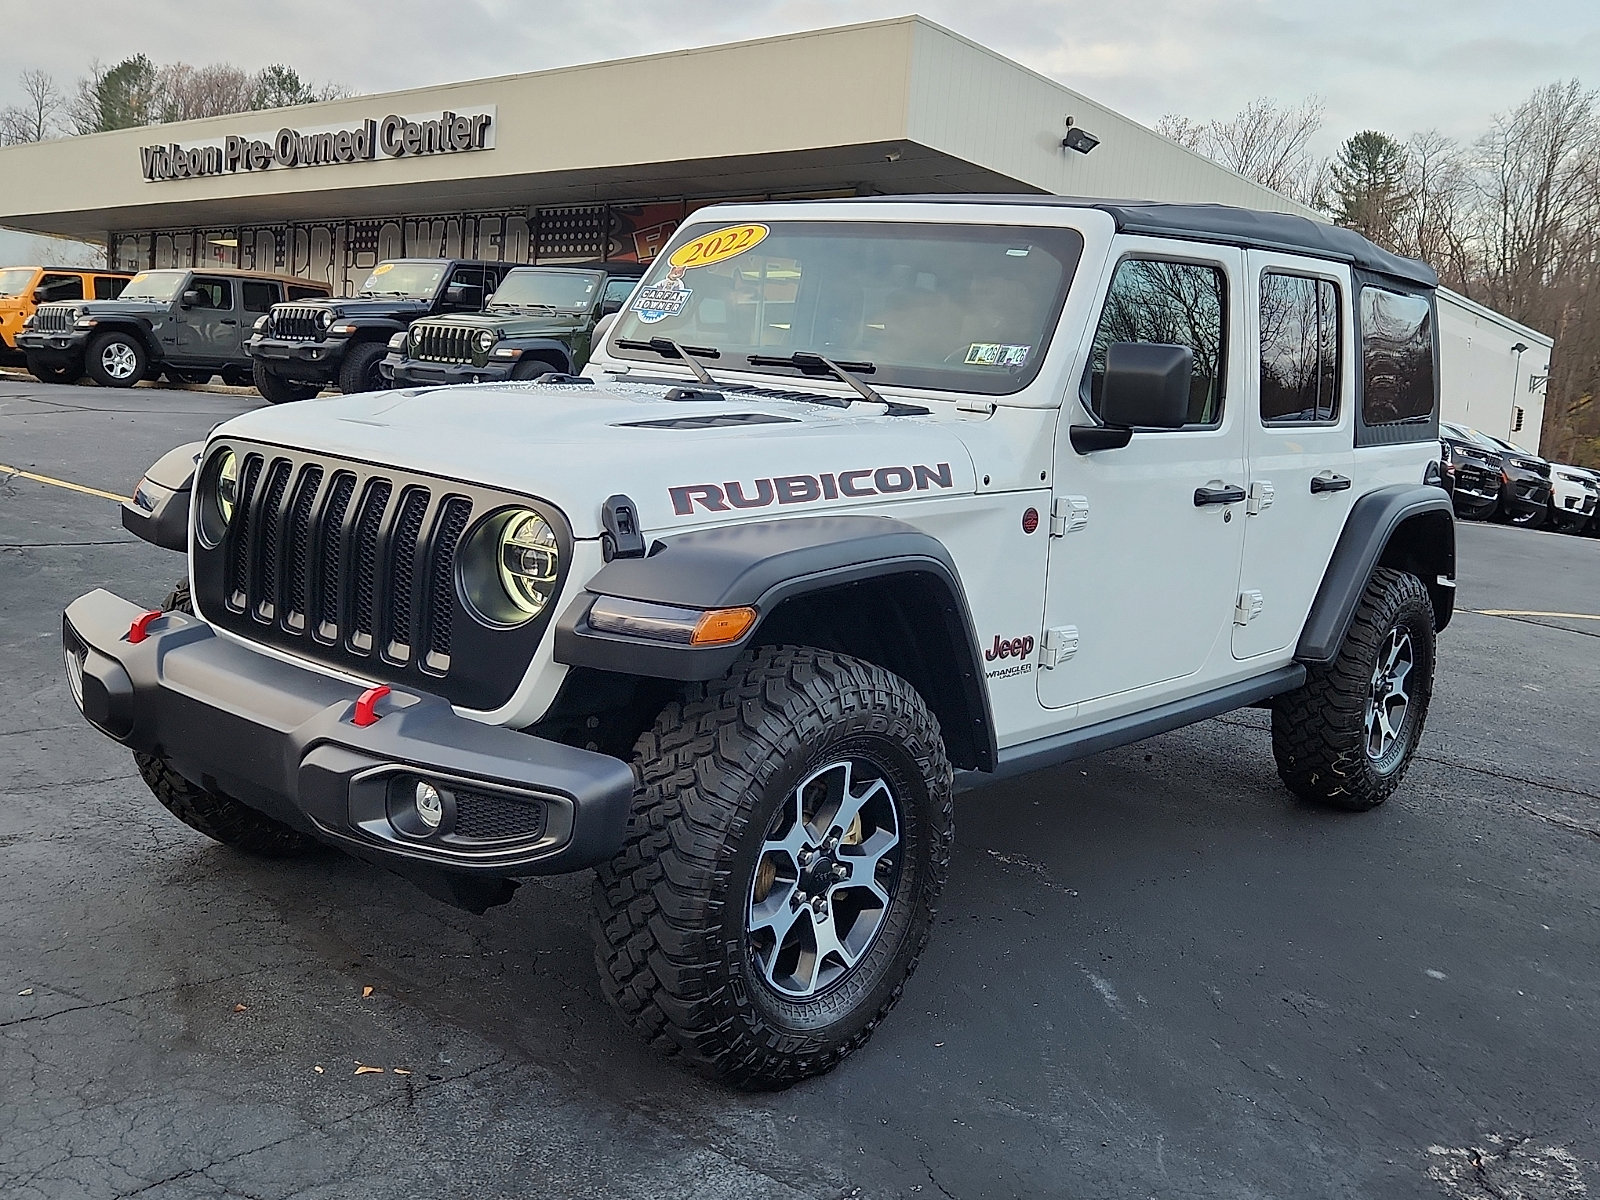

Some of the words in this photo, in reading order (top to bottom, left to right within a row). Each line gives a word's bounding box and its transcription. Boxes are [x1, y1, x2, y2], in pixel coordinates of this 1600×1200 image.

[139, 142, 222, 180] Videon
[224, 118, 376, 172] Pre-Owned
[379, 110, 491, 158] Center
[683, 228, 754, 264] 2022
[641, 289, 686, 302] CARFAX
[643, 300, 681, 312] OWNER
[668, 462, 953, 516] RUBICON
[985, 634, 1034, 662] Jeep
[985, 663, 1032, 678] WRANGLER
